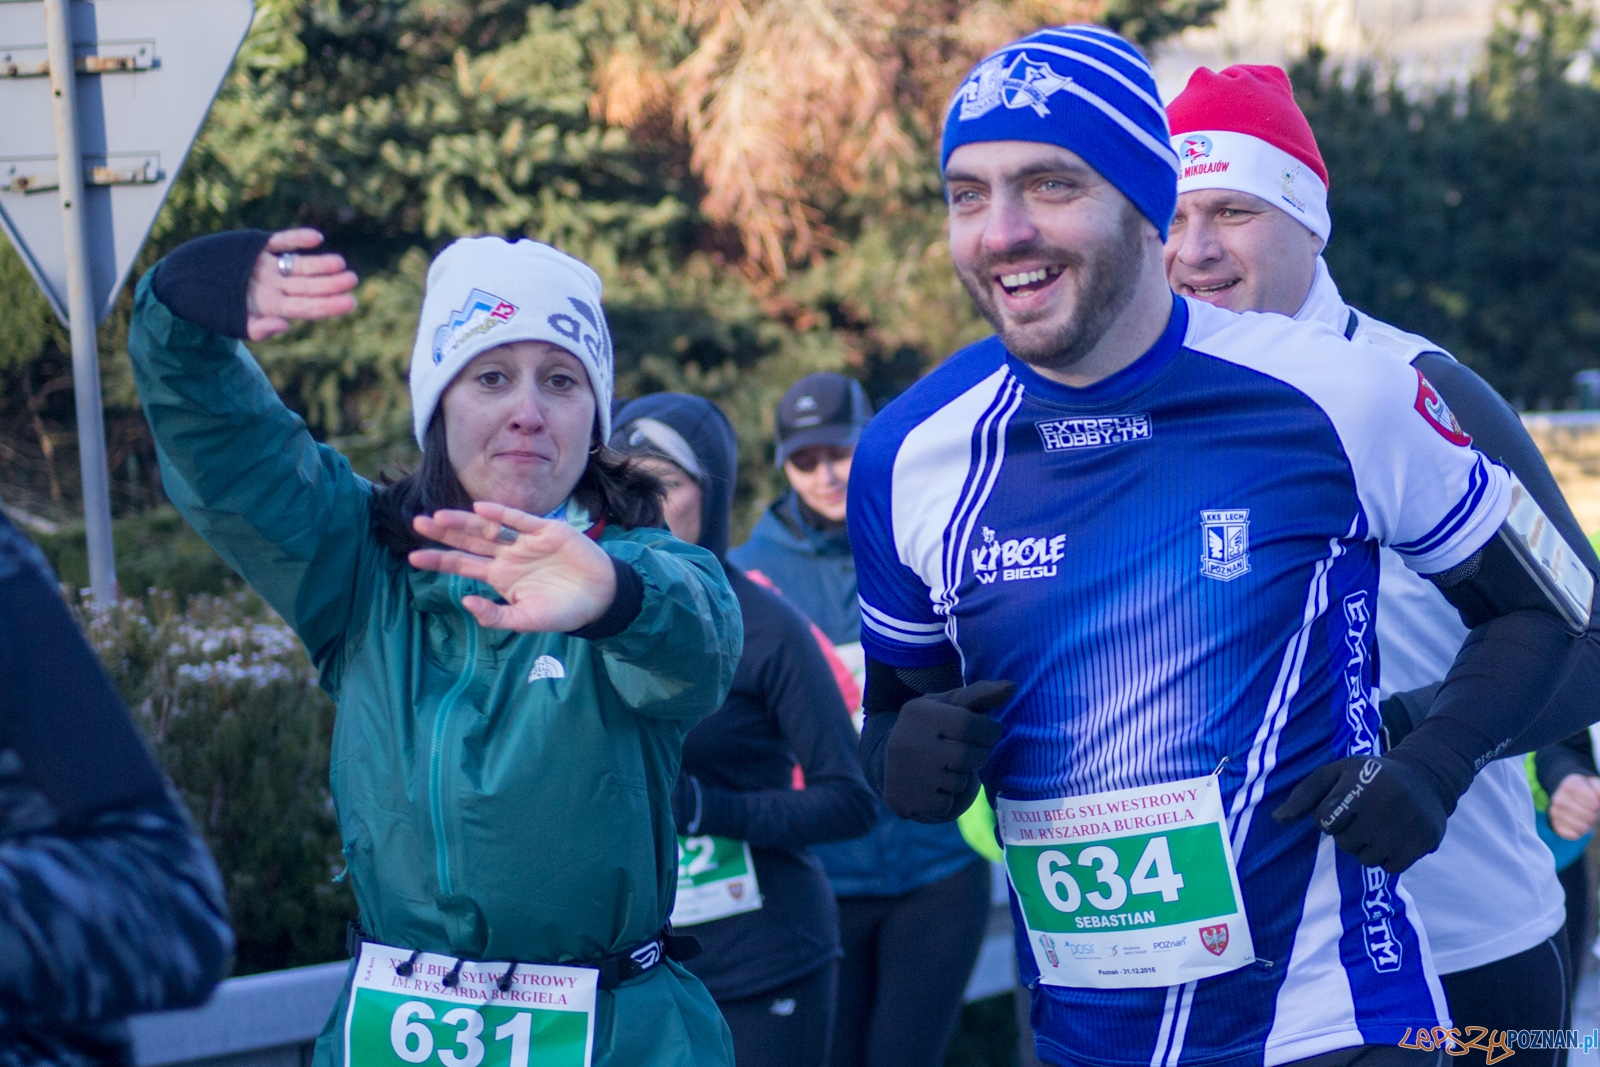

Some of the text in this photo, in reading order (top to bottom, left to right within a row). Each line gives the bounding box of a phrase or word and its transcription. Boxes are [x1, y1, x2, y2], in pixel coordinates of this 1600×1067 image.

[1184, 160, 1230, 178] MIKOŁAJÓW
[490, 302, 516, 320] 13
[1039, 415, 1148, 436] EXTREME
[975, 565, 1057, 584] W BIEGU
[1346, 598, 1372, 757] EXTREM
[1011, 788, 1197, 823] XXXII BIEG SYLWESTROWY
[1321, 784, 1364, 829] Kalenj
[1019, 808, 1195, 840] IM. RYSZARDA BURGIELA
[678, 834, 719, 877] 2
[1037, 836, 1184, 913] 634
[1075, 910, 1156, 929] SEBASTIAN
[391, 976, 568, 1005] IM. RYSZARDA BURGIELA
[427, 964, 450, 977] BIE
[462, 971, 577, 989] SYLWSTROWY
[390, 1000, 532, 1066] 631
